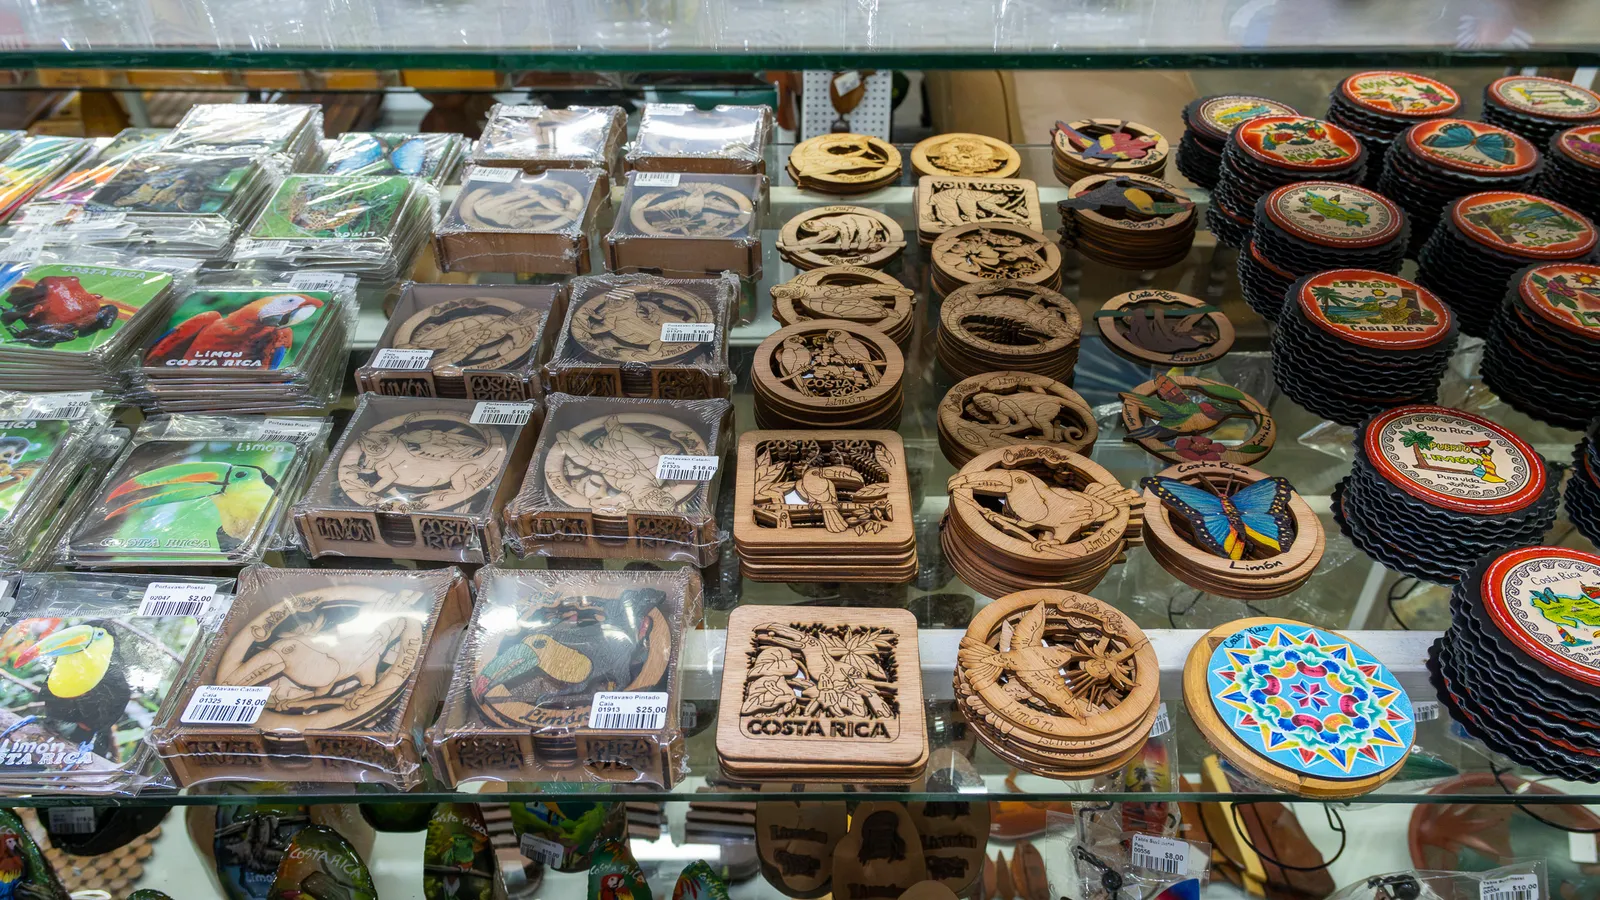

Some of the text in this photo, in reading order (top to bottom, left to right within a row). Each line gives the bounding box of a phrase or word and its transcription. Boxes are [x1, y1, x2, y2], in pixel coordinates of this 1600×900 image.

[932, 181, 1025, 192] COSTA RICA
[61, 266, 146, 280] COSTA RICA
[165, 359, 262, 368] COSTA RICA
[472, 376, 522, 391] COSTA
[806, 379, 853, 388] COSTA
[829, 386, 863, 397] RICA
[825, 396, 868, 407] Limón
[1416, 423, 1474, 435] Costa Rica
[766, 440, 873, 449] COSTA RICA
[1429, 441, 1472, 453] PUERTO
[1003, 447, 1037, 463] Costa
[1178, 461, 1249, 475] Costa Rica
[316, 516, 474, 542] LIMÓN COSTA
[164, 538, 211, 549] RICA
[1081, 527, 1120, 554] Limón
[1229, 560, 1283, 571] Limón
[1530, 571, 1583, 586] Costa Rica
[1061, 595, 1102, 614] Costa
[1223, 633, 1245, 648] Costa
[397, 637, 421, 680] Limón
[235, 698, 267, 706] $18.00
[518, 707, 589, 726] Limón
[636, 706, 667, 714] $25.00
[999, 701, 1054, 732] Limón
[746, 719, 891, 739] COSTA RICA
[1, 737, 66, 754] Limón
[38, 752, 93, 765] RICA
[289, 848, 361, 879] COSTA RICA
[1164, 852, 1184, 862] $8.00
[1512, 883, 1537, 891] $10.00
